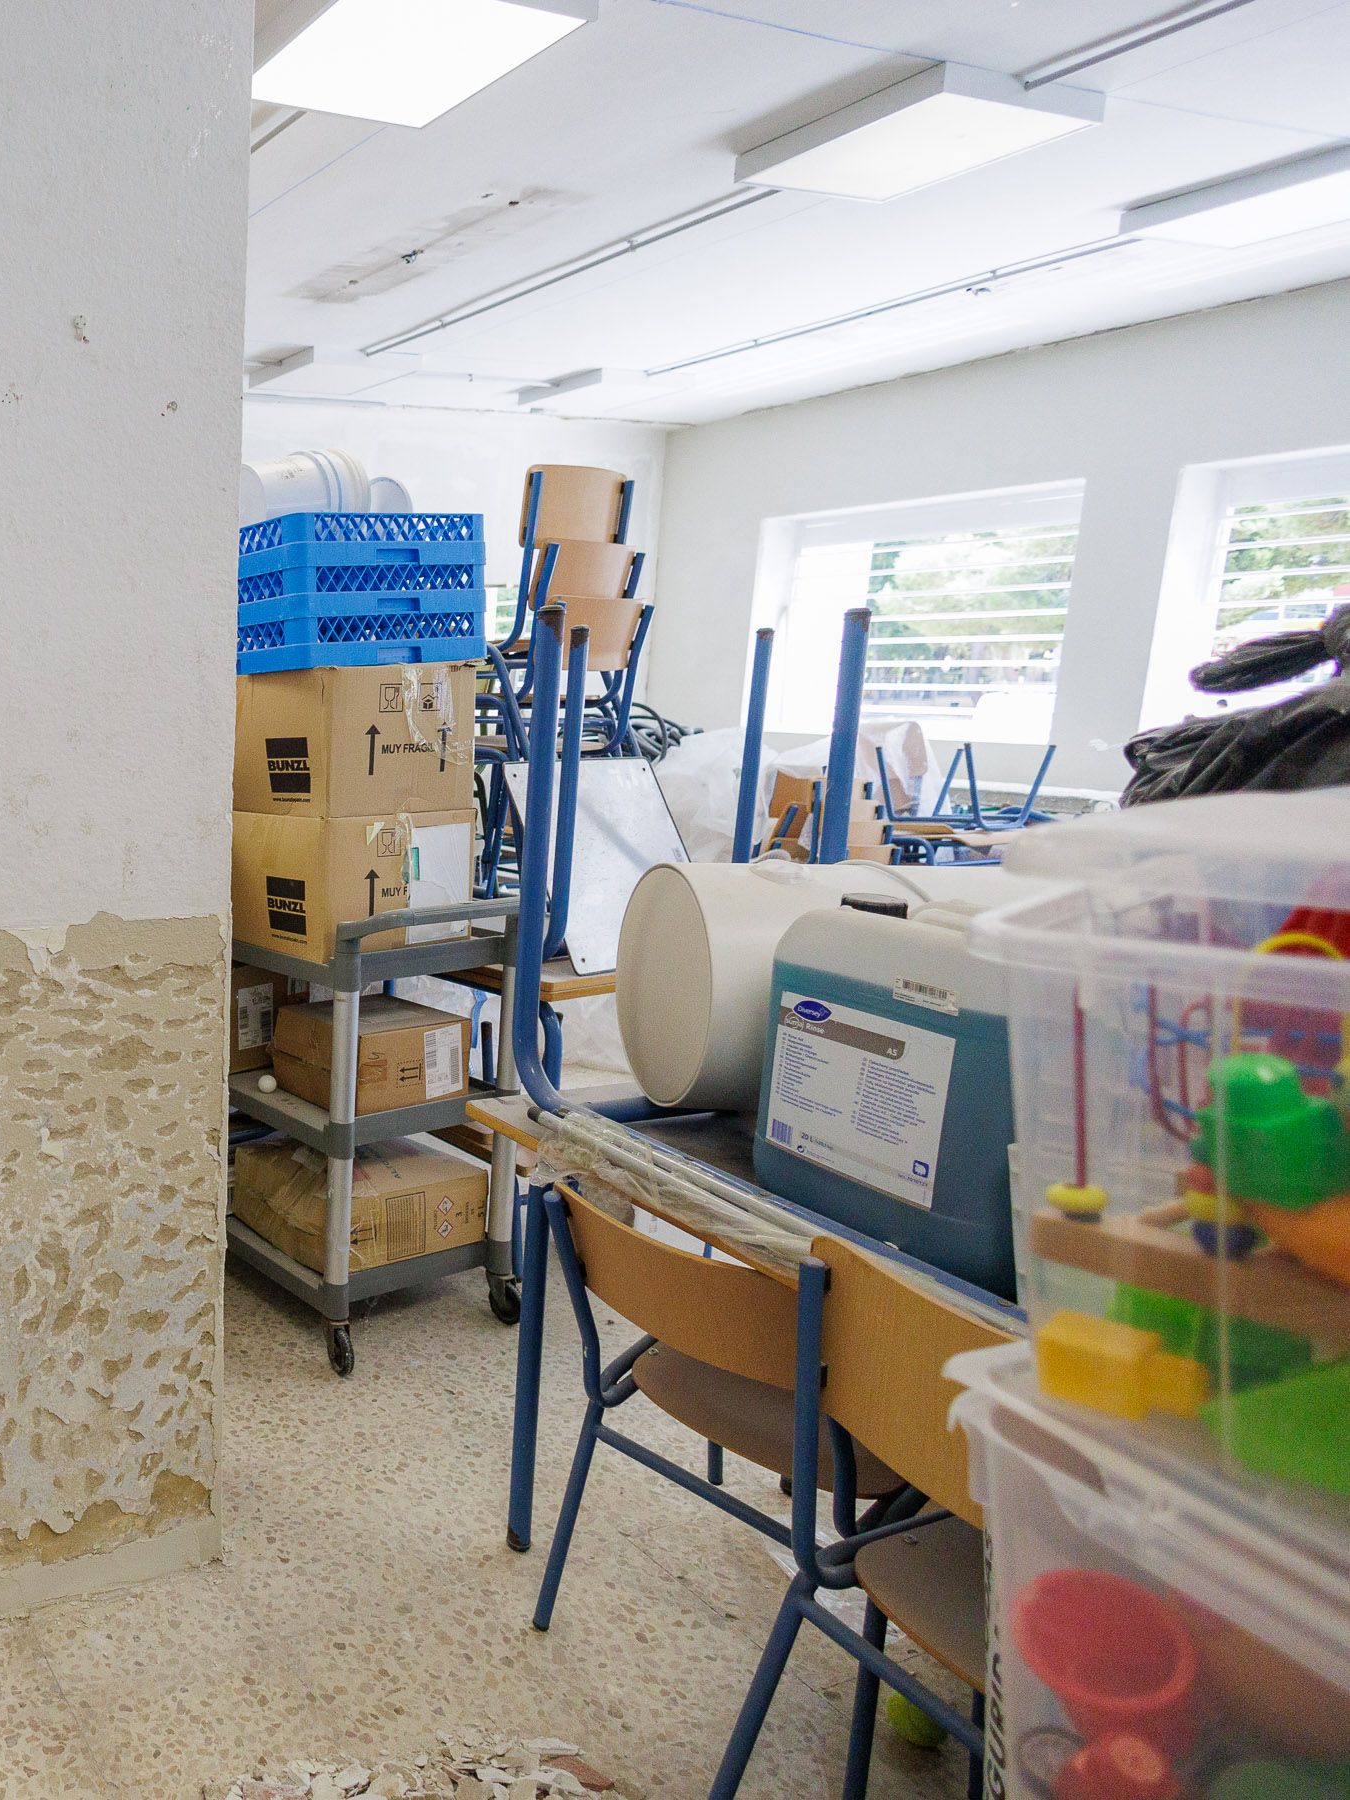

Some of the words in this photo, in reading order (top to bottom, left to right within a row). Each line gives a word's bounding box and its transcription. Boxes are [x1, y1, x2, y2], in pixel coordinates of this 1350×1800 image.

[381, 744, 401, 754] MUY
[268, 760, 310, 772] BUNZL
[381, 887, 401, 898] MUY
[266, 898, 306, 914] BUNZL
[797, 1005, 822, 1019] Diversey
[805, 1022, 826, 1035] Rinse
